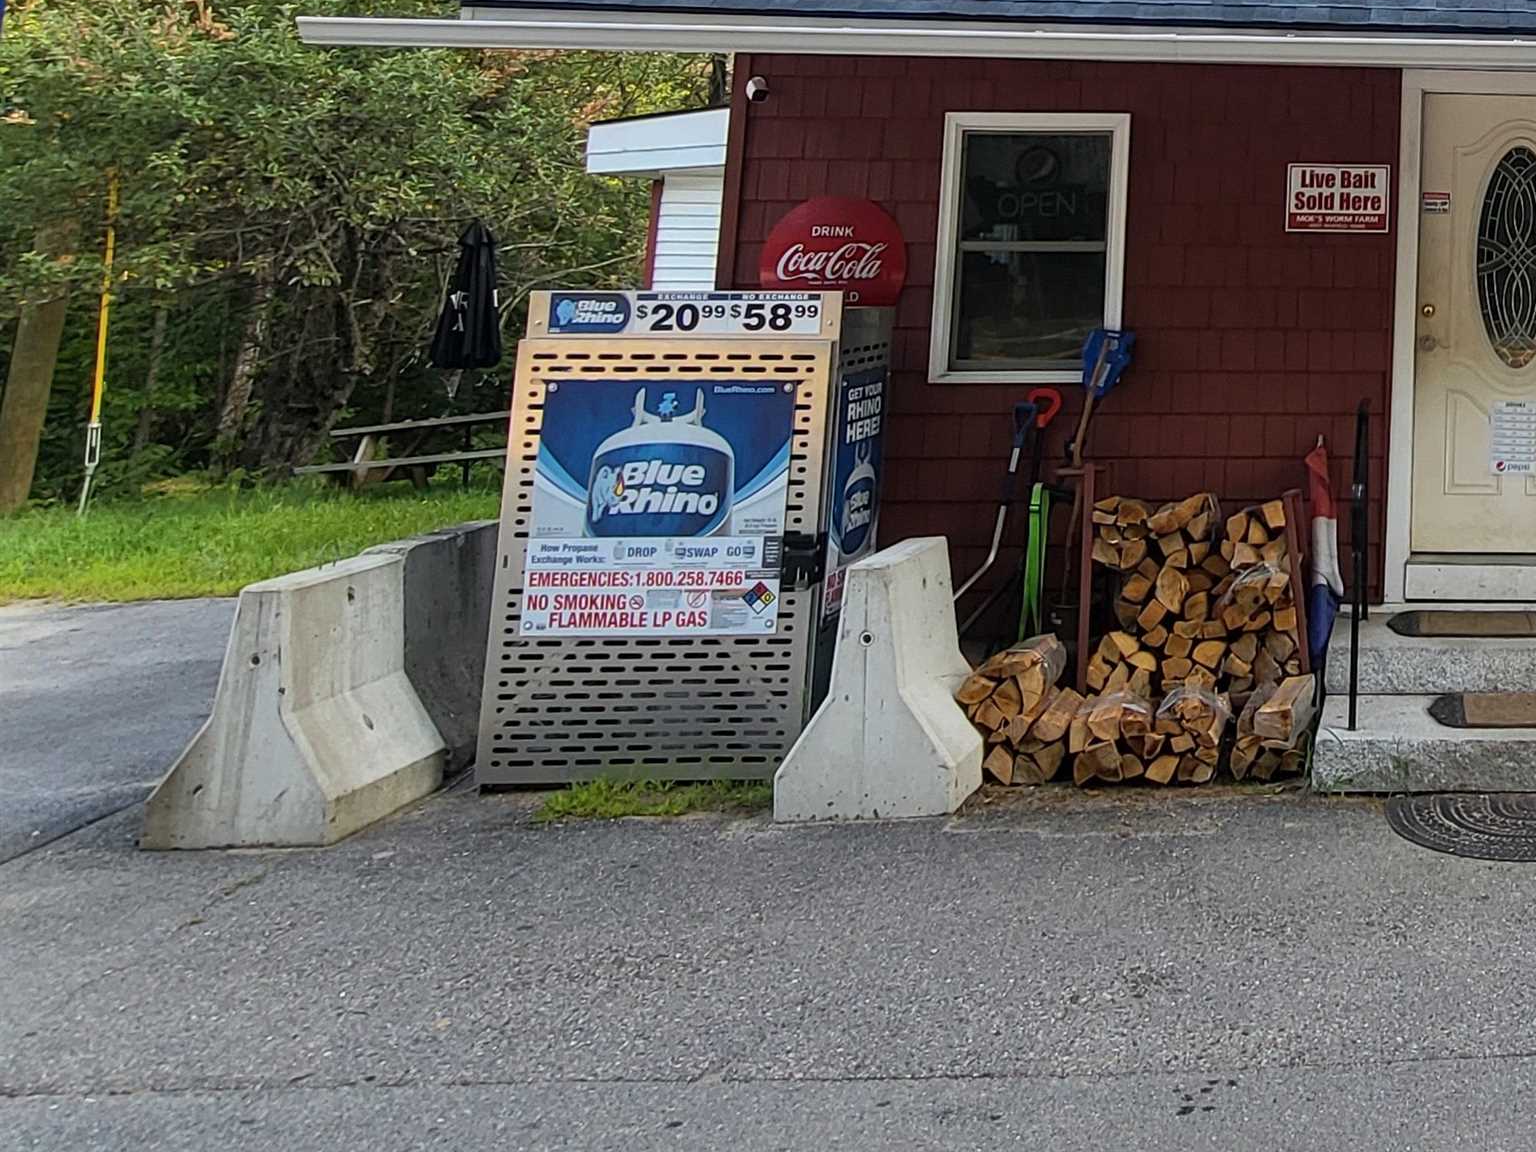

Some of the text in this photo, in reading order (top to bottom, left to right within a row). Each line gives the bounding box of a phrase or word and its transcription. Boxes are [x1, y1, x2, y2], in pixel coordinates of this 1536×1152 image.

[1300, 169, 1377, 189] Live Bait
[997, 191, 1076, 218] OPEN
[1294, 191, 1382, 211] Sold Here
[1354, 215, 1379, 223] FARM
[811, 225, 854, 237] DRINK
[776, 242, 888, 281] Coca-Cola
[578, 299, 616, 312] Blue
[714, 385, 775, 394] BlueRhino.com
[848, 386, 864, 401] GET
[847, 395, 881, 421] RHINO
[624, 459, 705, 486] Blue
[1507, 462, 1530, 471] pepsi
[608, 486, 719, 516] Rhino
[540, 543, 561, 553] How
[627, 546, 658, 558] DROP
[686, 547, 719, 558] SWAP
[726, 546, 742, 557] GO
[531, 554, 573, 566] Exchange
[527, 594, 627, 611] NO SMOKING
[549, 610, 708, 629] FLAMMABLE LP GAS
